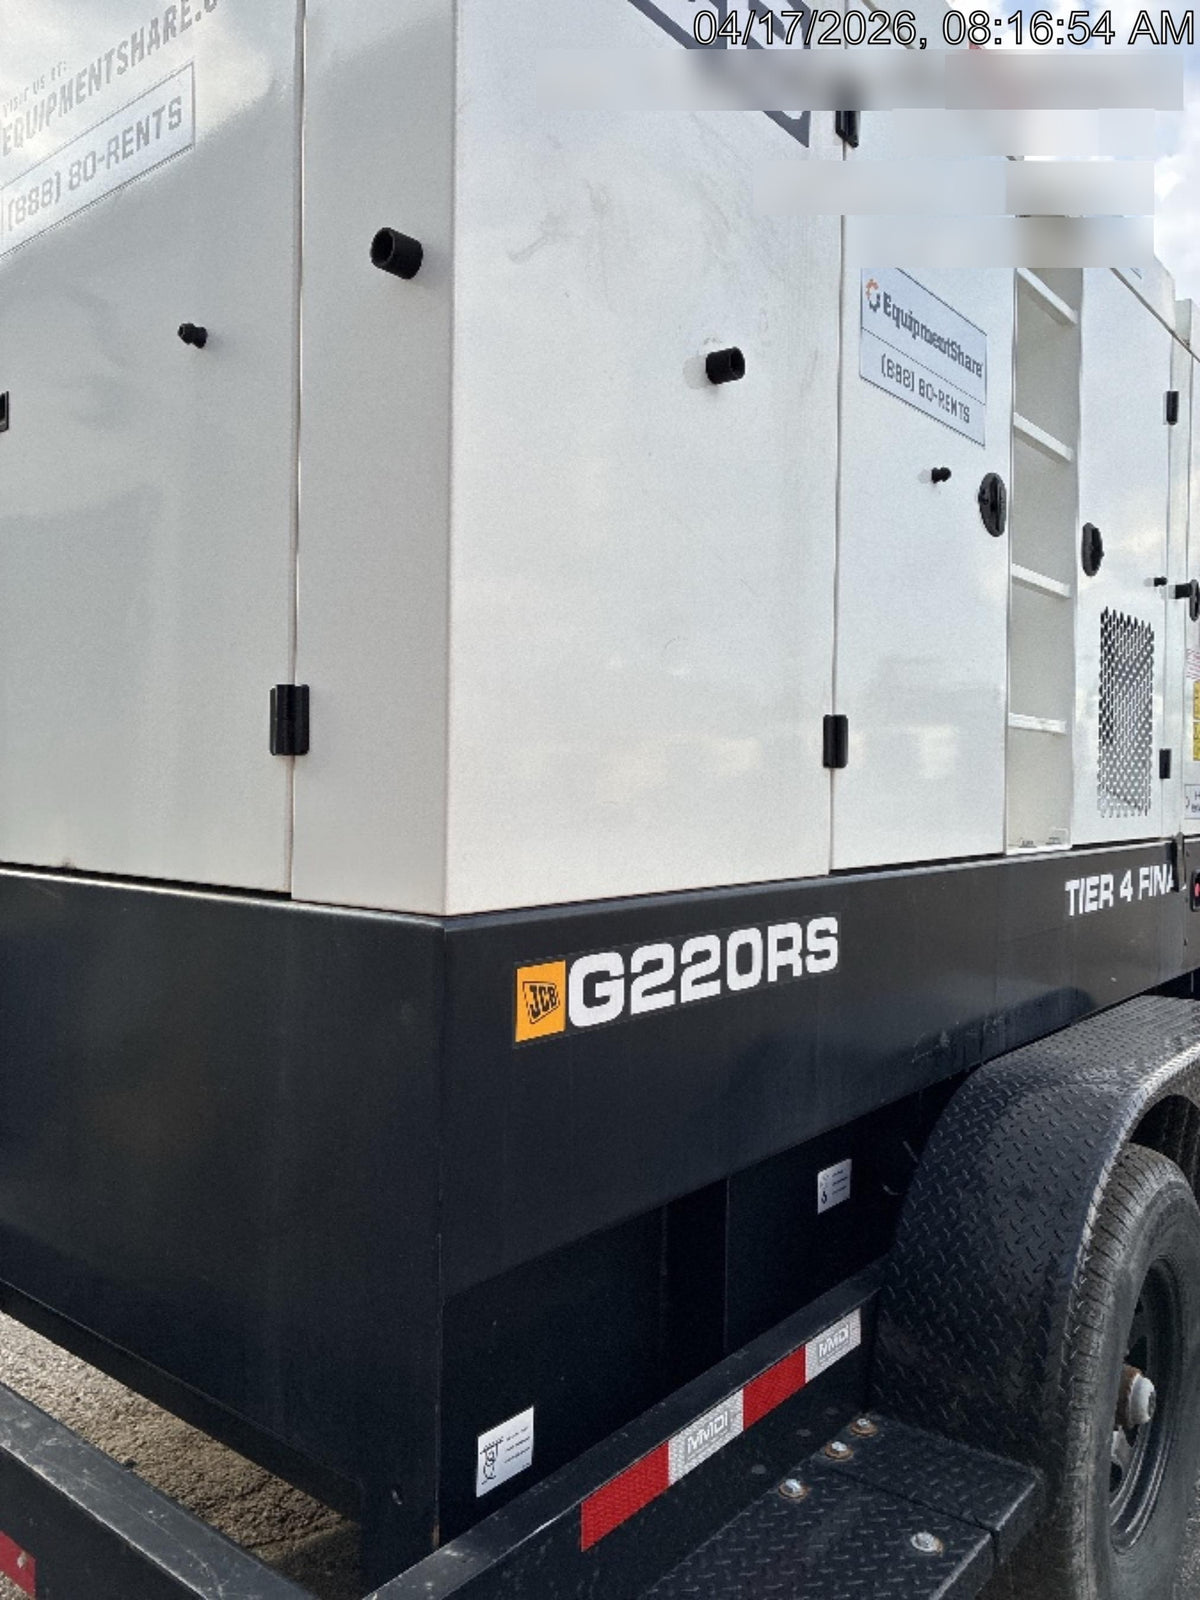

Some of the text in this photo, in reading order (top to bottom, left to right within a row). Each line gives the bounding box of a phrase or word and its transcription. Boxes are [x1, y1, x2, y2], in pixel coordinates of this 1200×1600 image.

[8, 95, 183, 232] (888) 80-RENTS
[882, 291, 983, 378] EquipmentShare
[881, 353, 971, 424] (888) 80-RENTS
[1065, 873, 1115, 916] TIER
[1120, 868, 1134, 902] 4
[529, 985, 557, 1019] JCB
[568, 916, 839, 1028] G220RS
